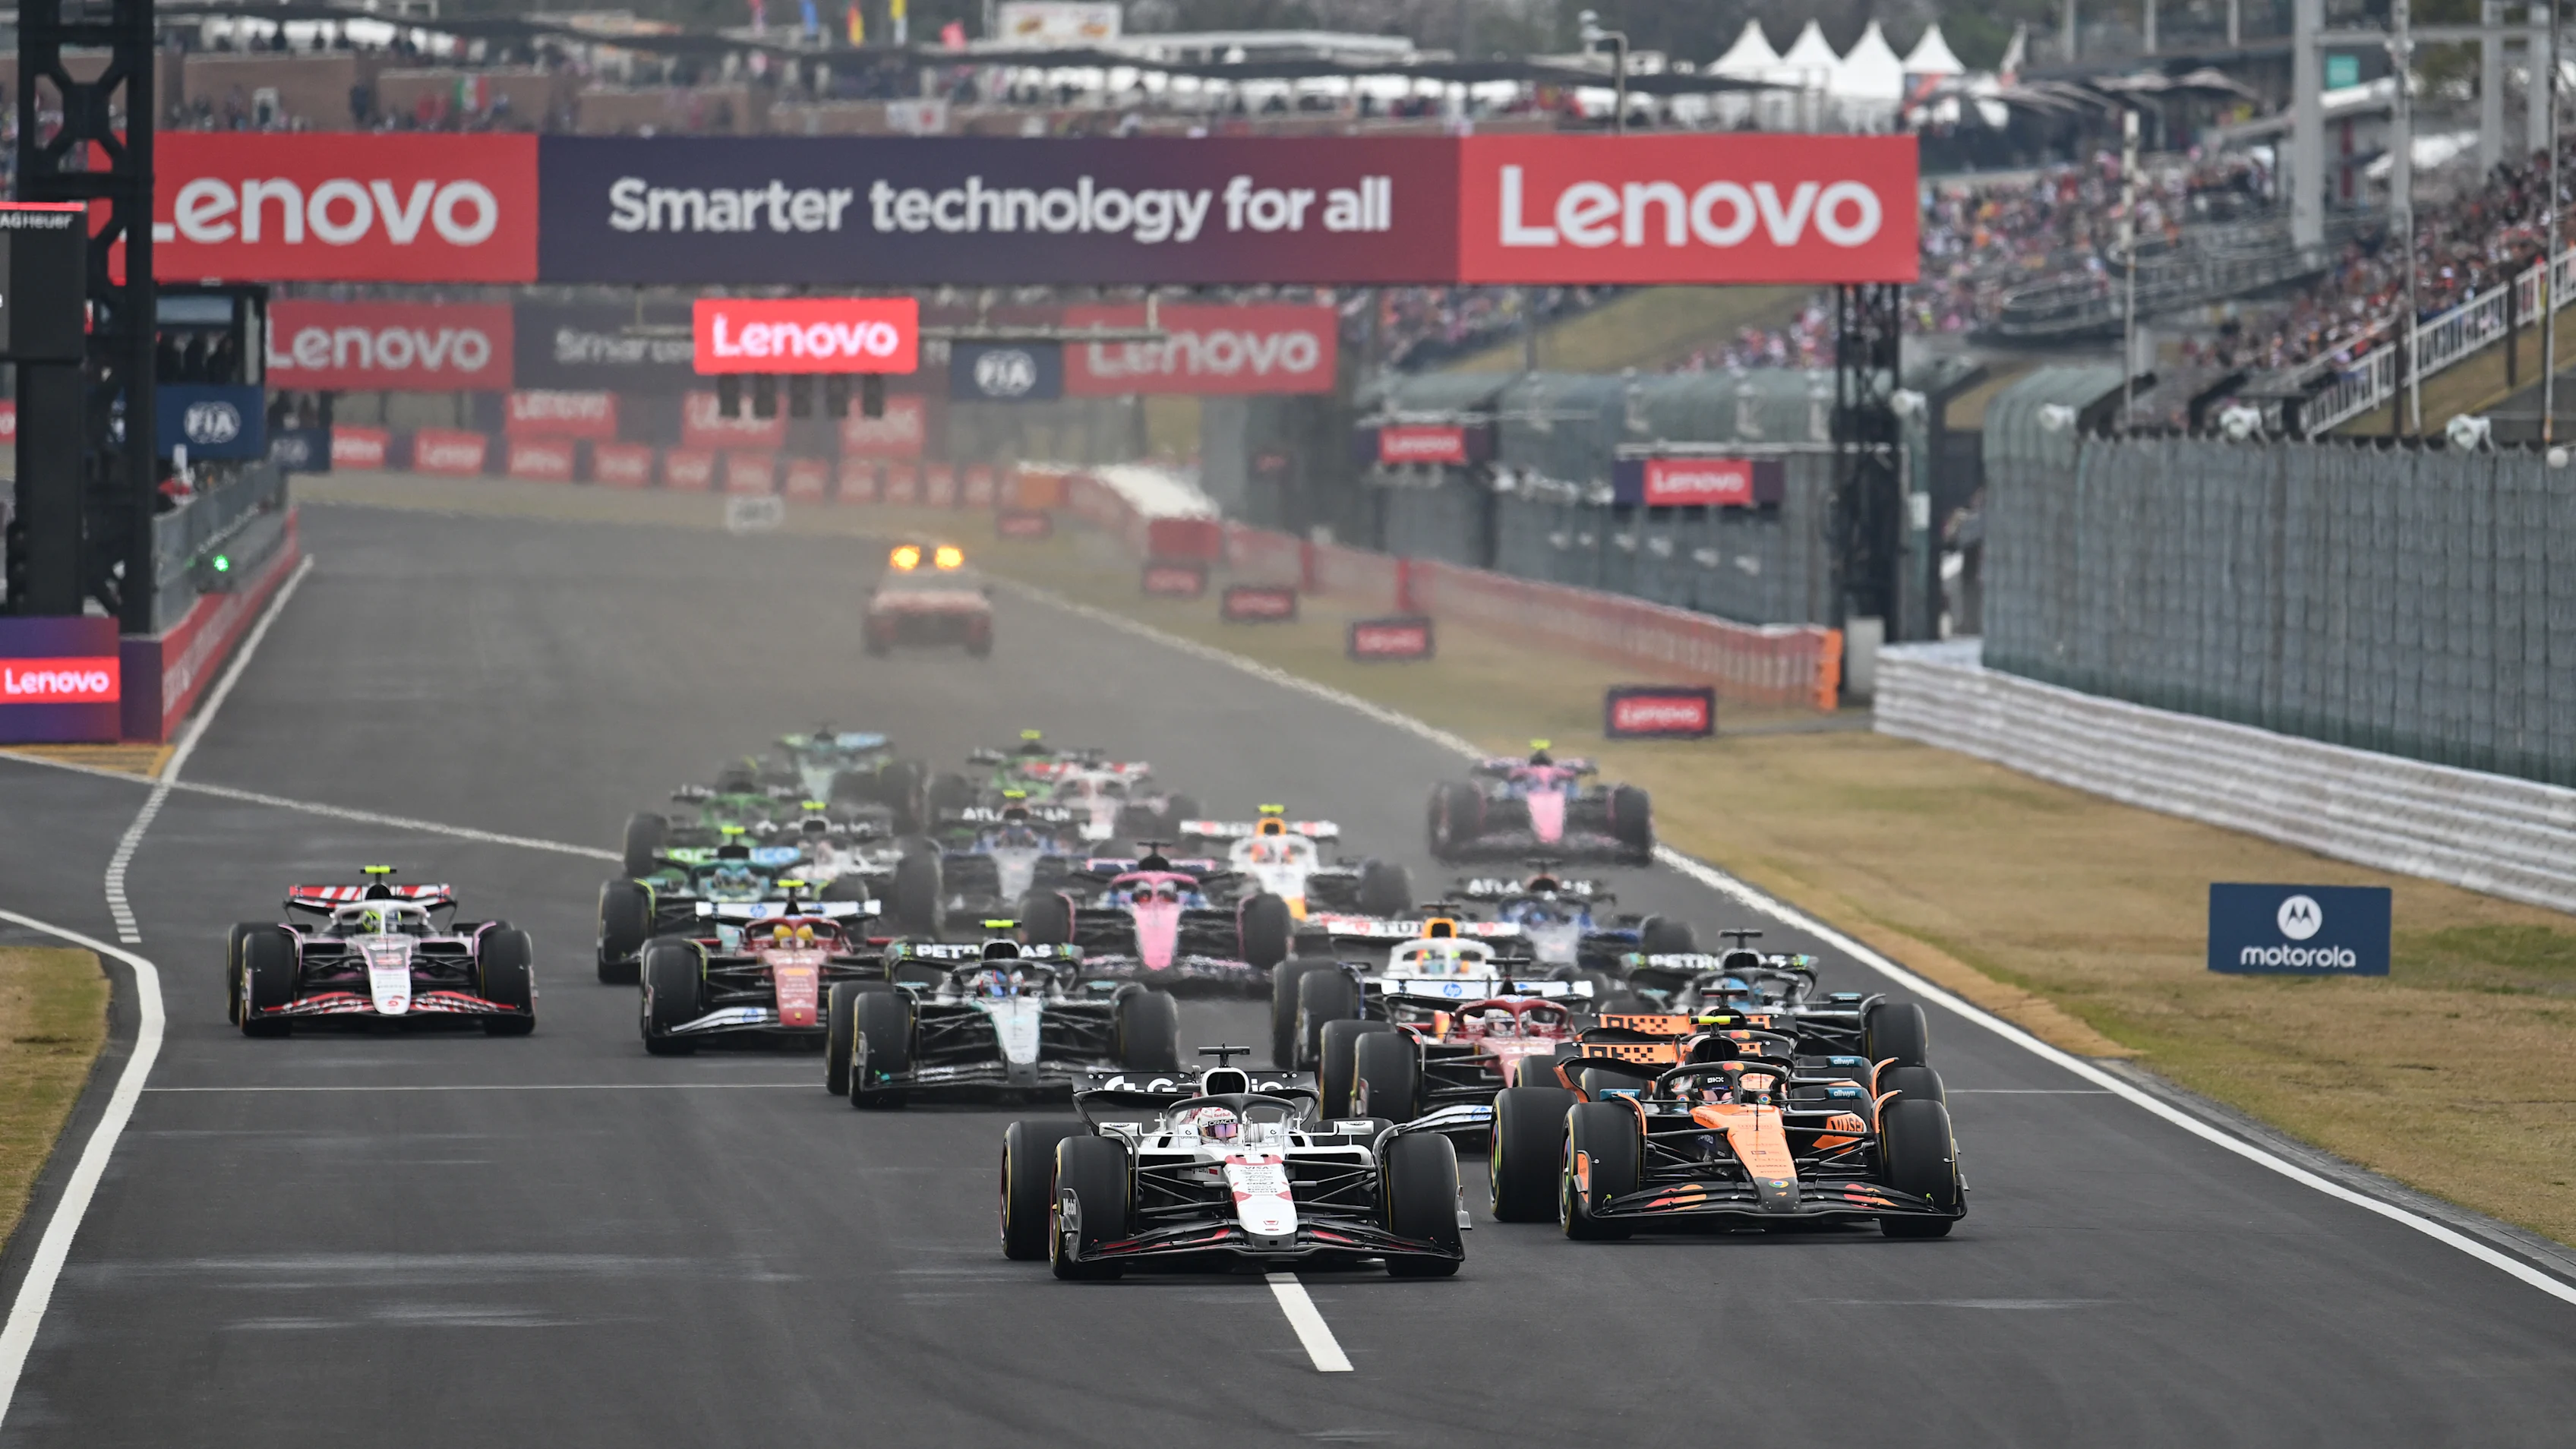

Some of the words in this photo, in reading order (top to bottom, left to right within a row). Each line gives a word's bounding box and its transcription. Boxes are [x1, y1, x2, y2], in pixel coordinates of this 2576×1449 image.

[609, 176, 852, 232] Smarter
[870, 176, 1210, 242] technology
[1223, 176, 1315, 231] for
[1323, 176, 1392, 231] all
[1500, 165, 1883, 247] Lenovo
[266, 320, 490, 370] Lenovo
[712, 313, 900, 358] Lenovo
[977, 352, 1034, 393] FIA
[186, 404, 238, 439] FIA
[1653, 468, 1744, 494] Lenovo
[5, 668, 110, 695] Lenovo
[916, 944, 1052, 960] PETRAS
[2240, 944, 2356, 968] motorola
